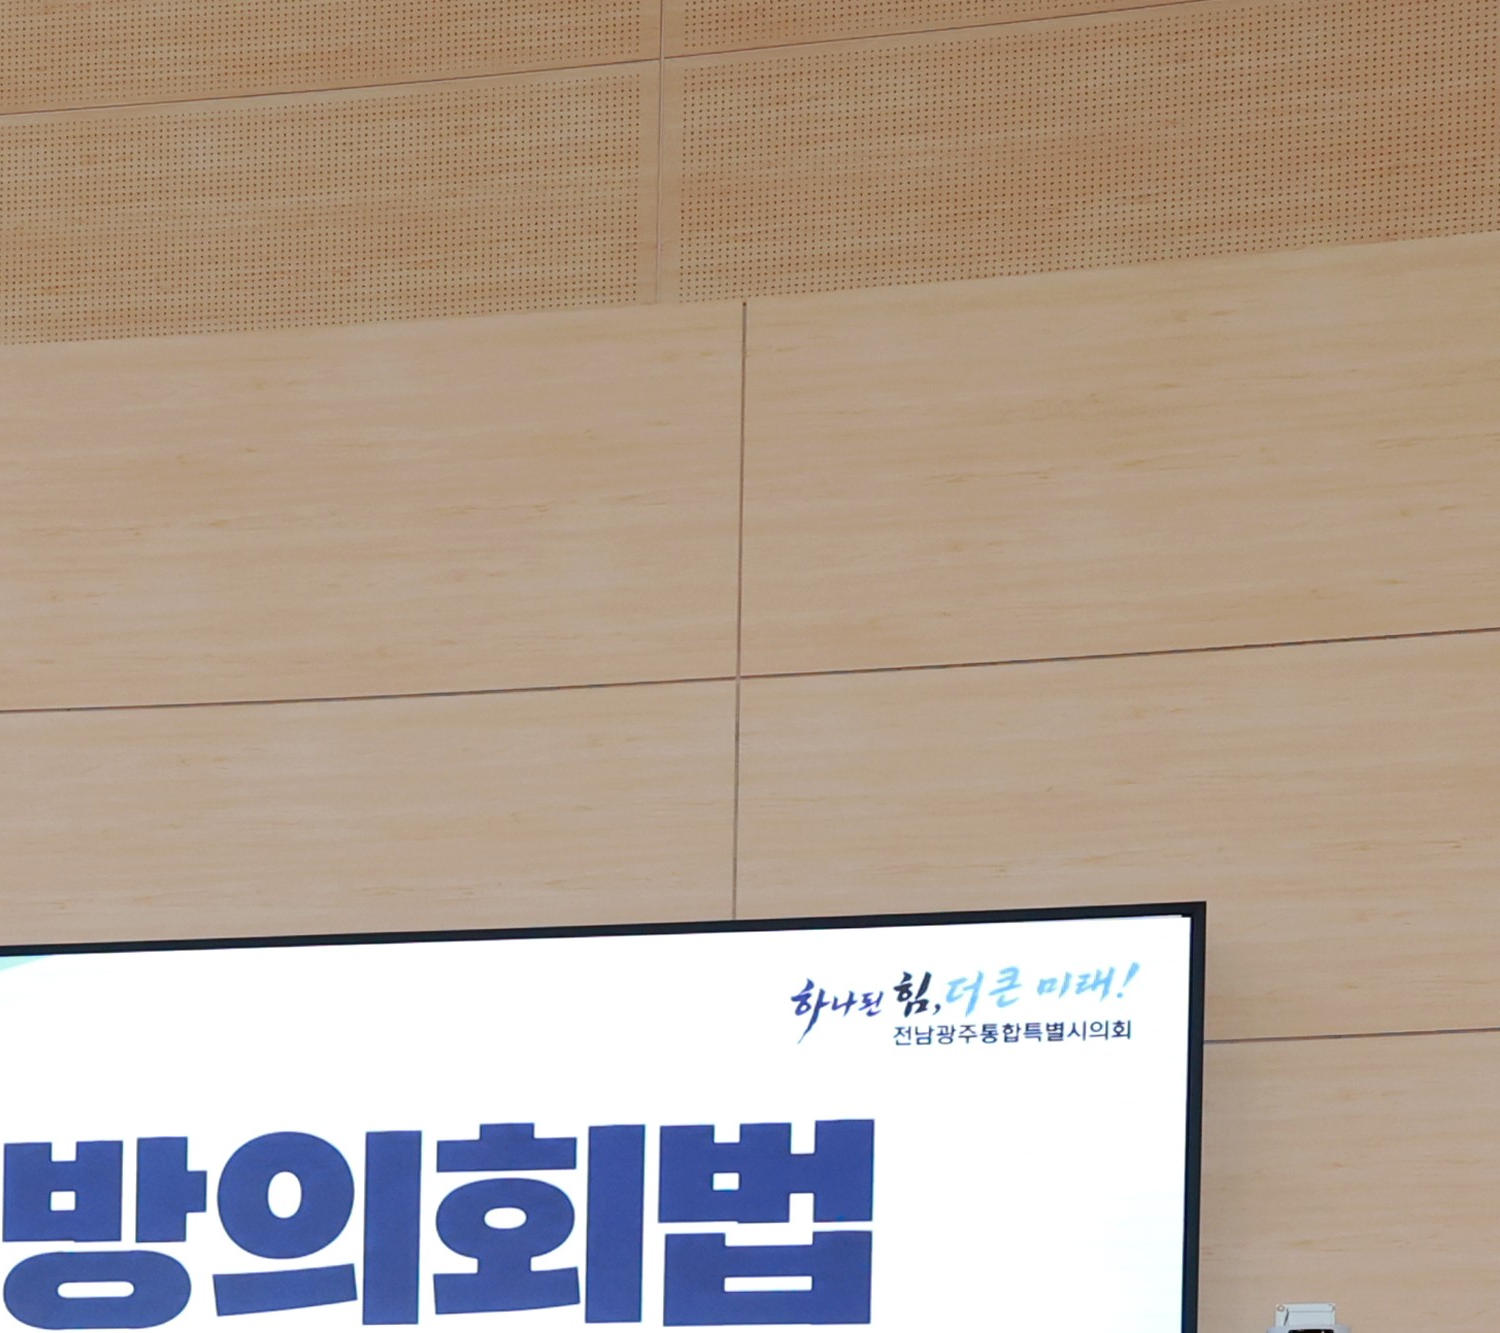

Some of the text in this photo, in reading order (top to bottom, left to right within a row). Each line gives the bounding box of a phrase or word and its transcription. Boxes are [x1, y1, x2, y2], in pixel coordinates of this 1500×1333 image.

[790, 961, 1140, 1044] 하나된 힘, 더 큰 미래!
[893, 1020, 1132, 1046] 전남광주통합특별시의회
